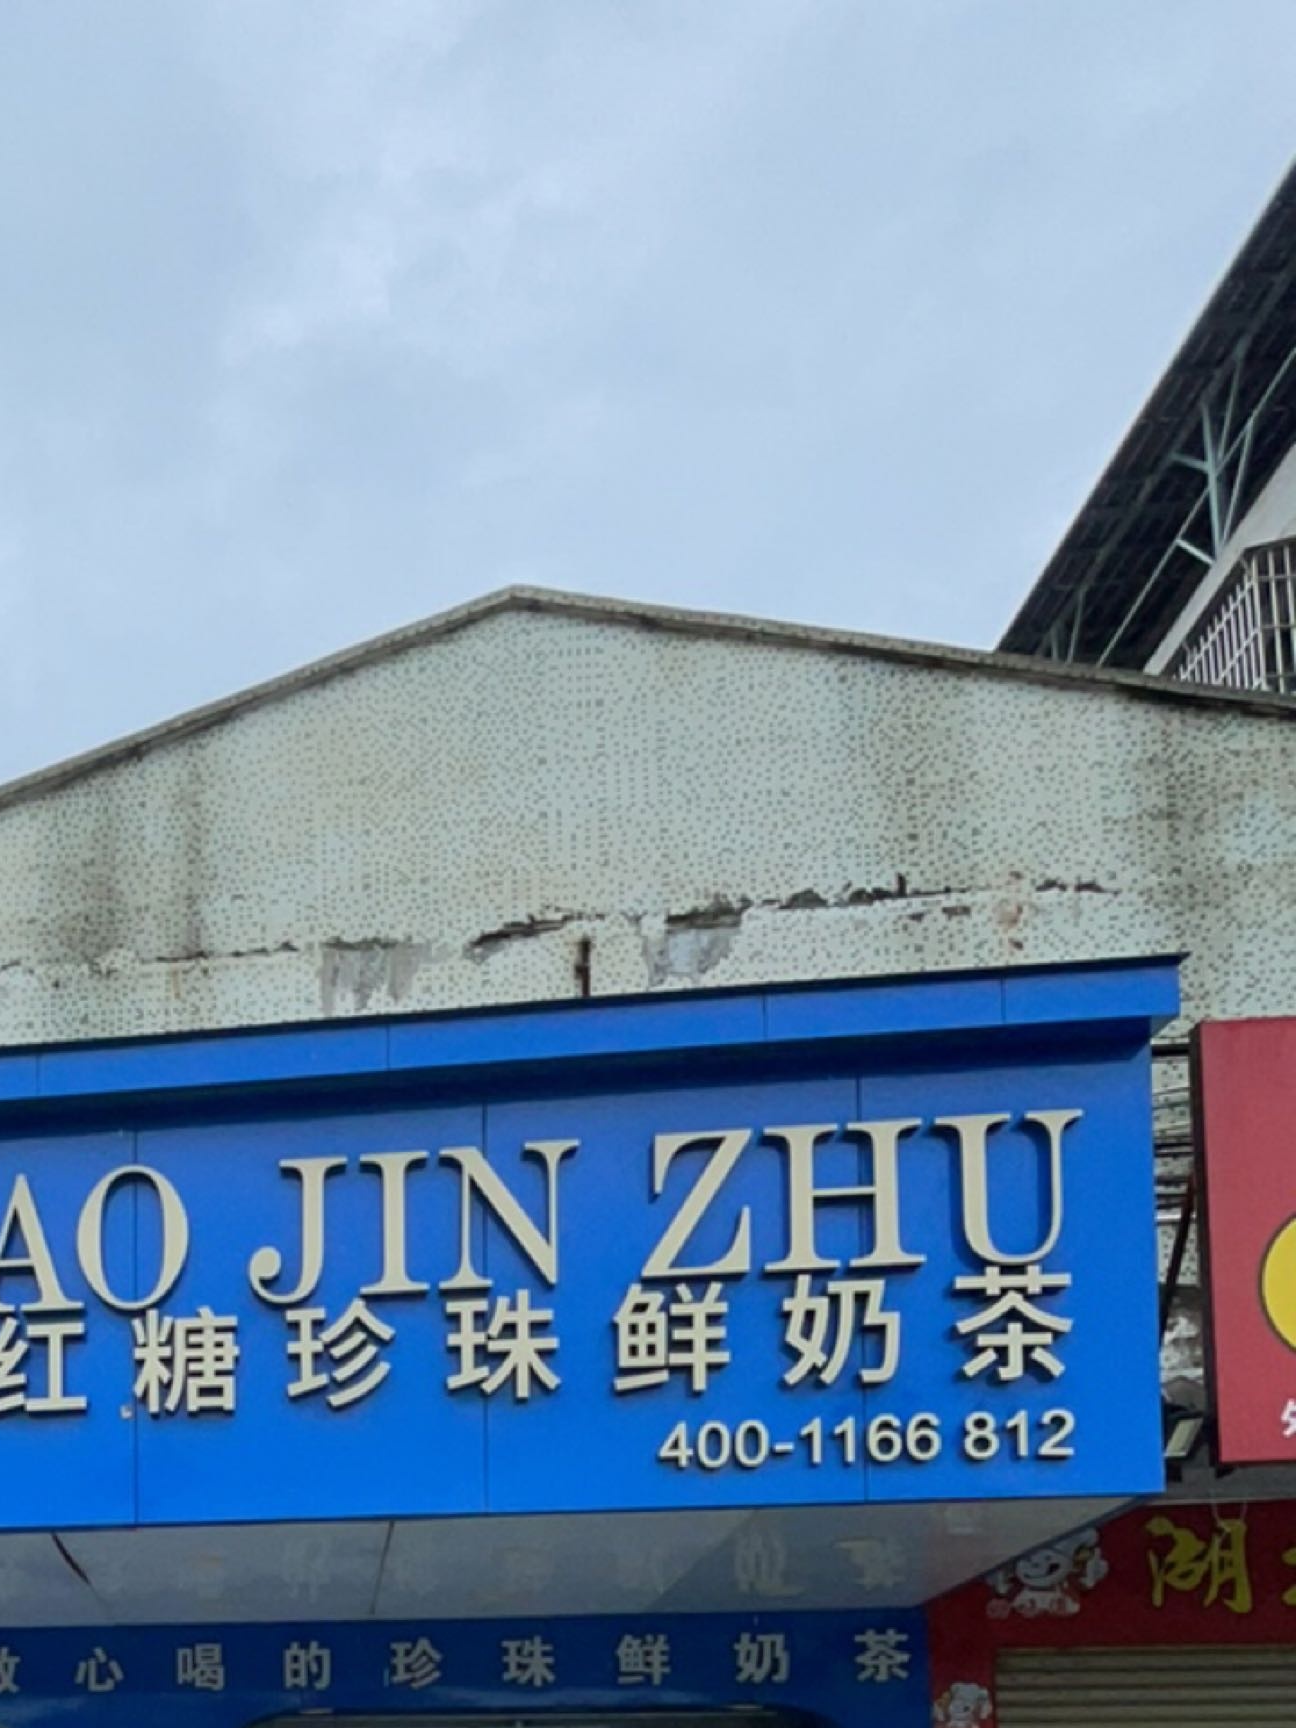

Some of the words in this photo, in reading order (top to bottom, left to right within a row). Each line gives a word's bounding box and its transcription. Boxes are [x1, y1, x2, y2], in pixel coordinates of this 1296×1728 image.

[248, 1140, 582, 1305] JIN
[641, 1108, 1084, 1280] ZHU
[657, 1411, 943, 1470] 400-1166
[962, 1409, 1077, 1461] 812
[1145, 1515, 1296, 1614] 湖
